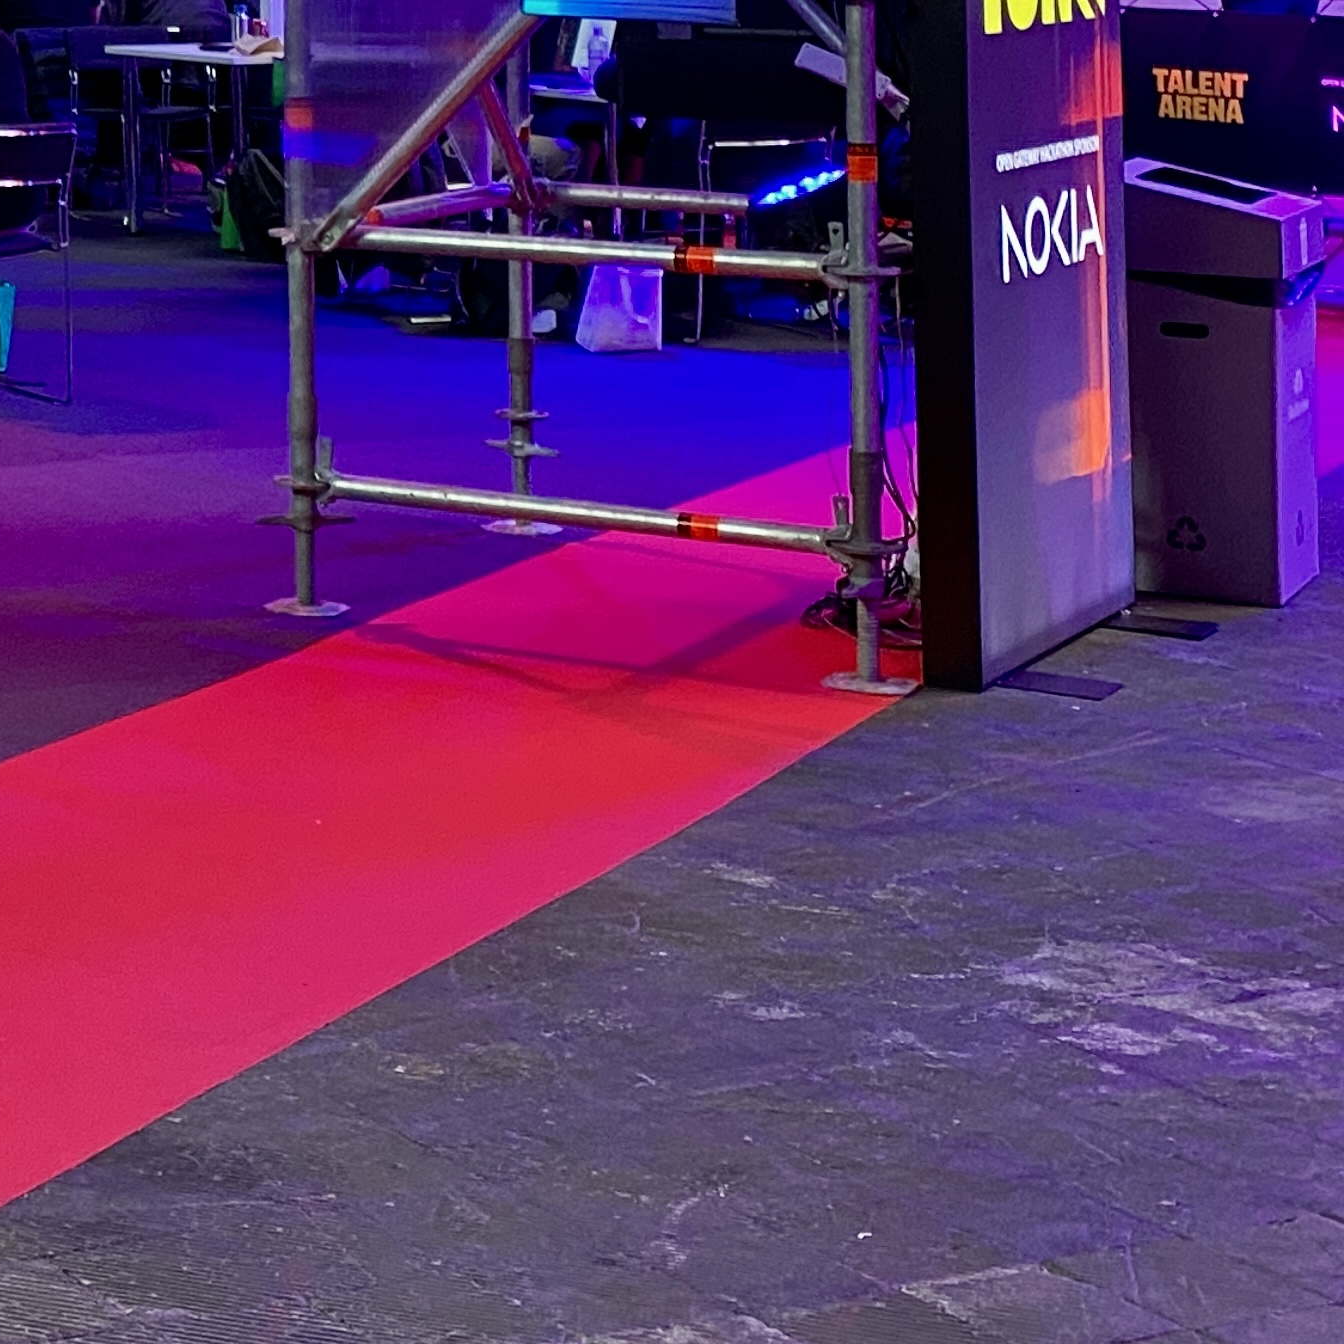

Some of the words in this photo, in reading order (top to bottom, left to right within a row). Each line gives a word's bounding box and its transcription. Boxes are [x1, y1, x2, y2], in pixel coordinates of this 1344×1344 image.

[1152, 67, 1249, 99] TALENT
[1158, 94, 1244, 124] ARENA
[1000, 184, 1105, 284] NOKIA
